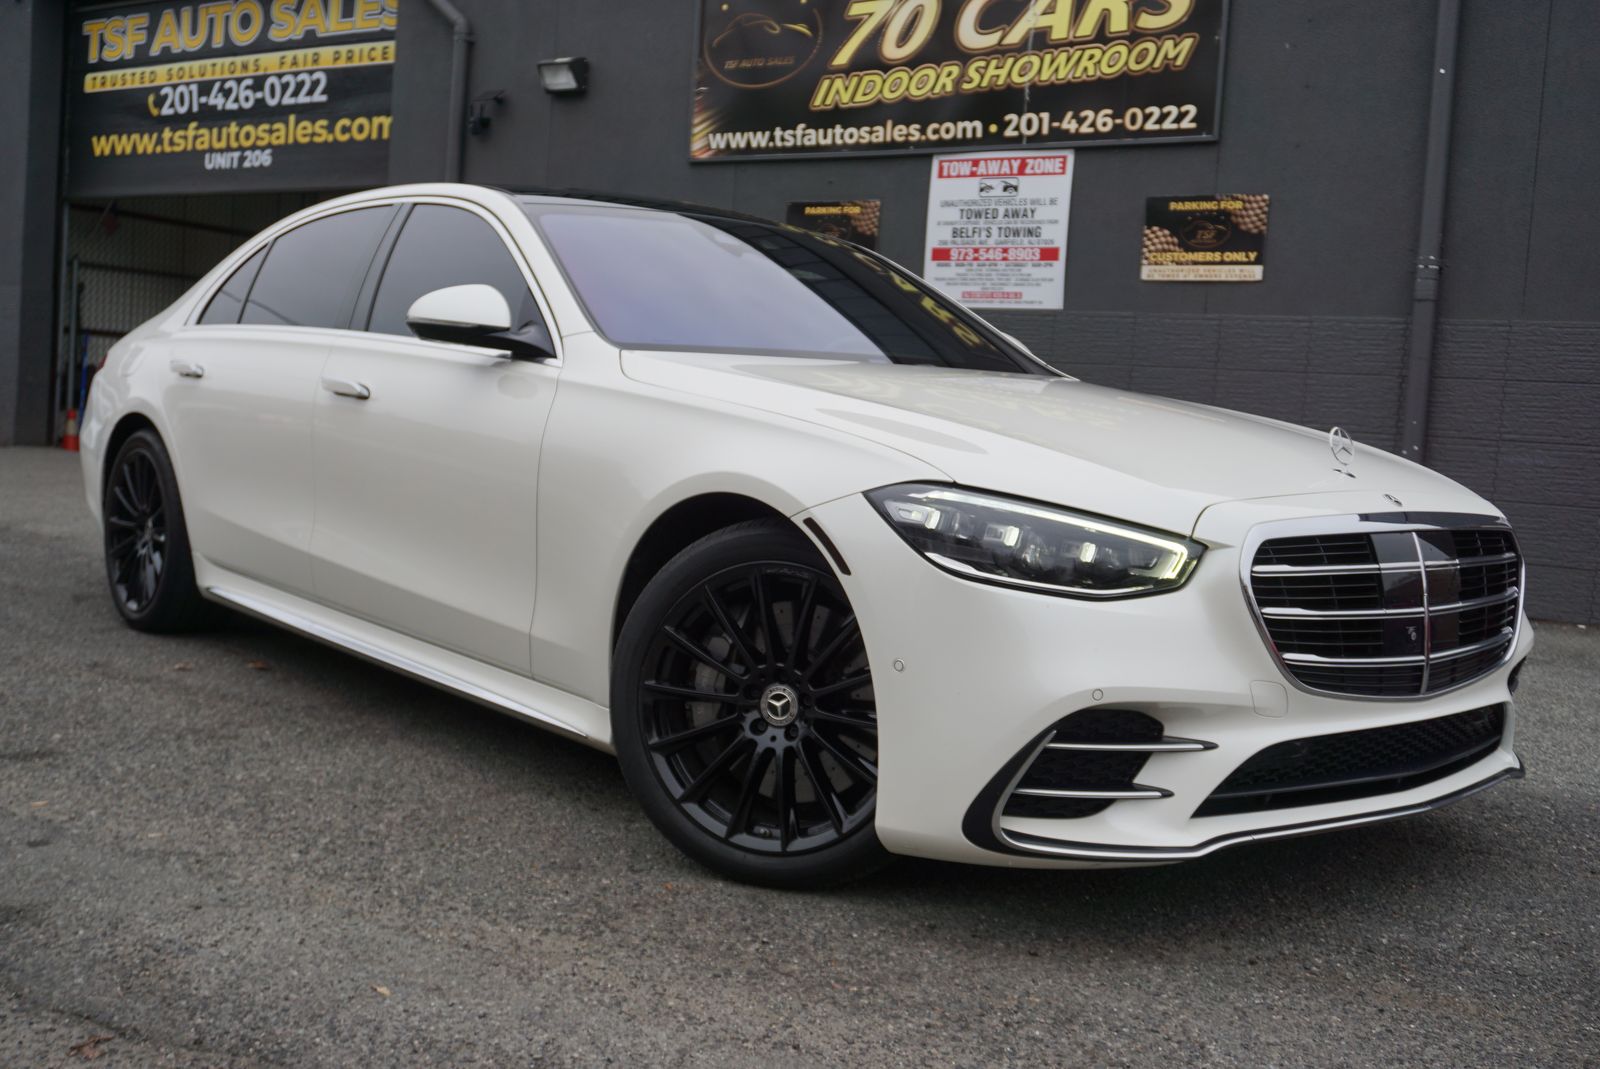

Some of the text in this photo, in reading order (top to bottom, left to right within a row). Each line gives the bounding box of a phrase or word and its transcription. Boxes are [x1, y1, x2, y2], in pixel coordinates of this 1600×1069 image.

[82, 13, 149, 64] TSF
[149, 0, 264, 57] AUTO
[829, 0, 940, 67] 70
[91, 70, 157, 89] TRUSTED
[279, 52, 321, 69] FAIR
[333, 46, 390, 65] PRICE
[812, 35, 1198, 107] INDOOR SHOWROOM
[159, 71, 328, 117] 201-426-0222
[91, 114, 393, 157] www.tsfautosales.com
[708, 104, 1198, 150] www.tsfautosales.com 201-426-0222
[204, 149, 273, 170] UNIT 206
[941, 157, 1064, 176] TOW-AWAY ZONE
[960, 206, 1037, 220] TOWED AWAY
[1169, 200, 1244, 211] PARKING FOR
[951, 225, 1042, 239] BELFI'S TOWING
[949, 247, 1041, 261] 973-546-8903
[1149, 251, 1258, 262] CUSTOMERS ONLY
